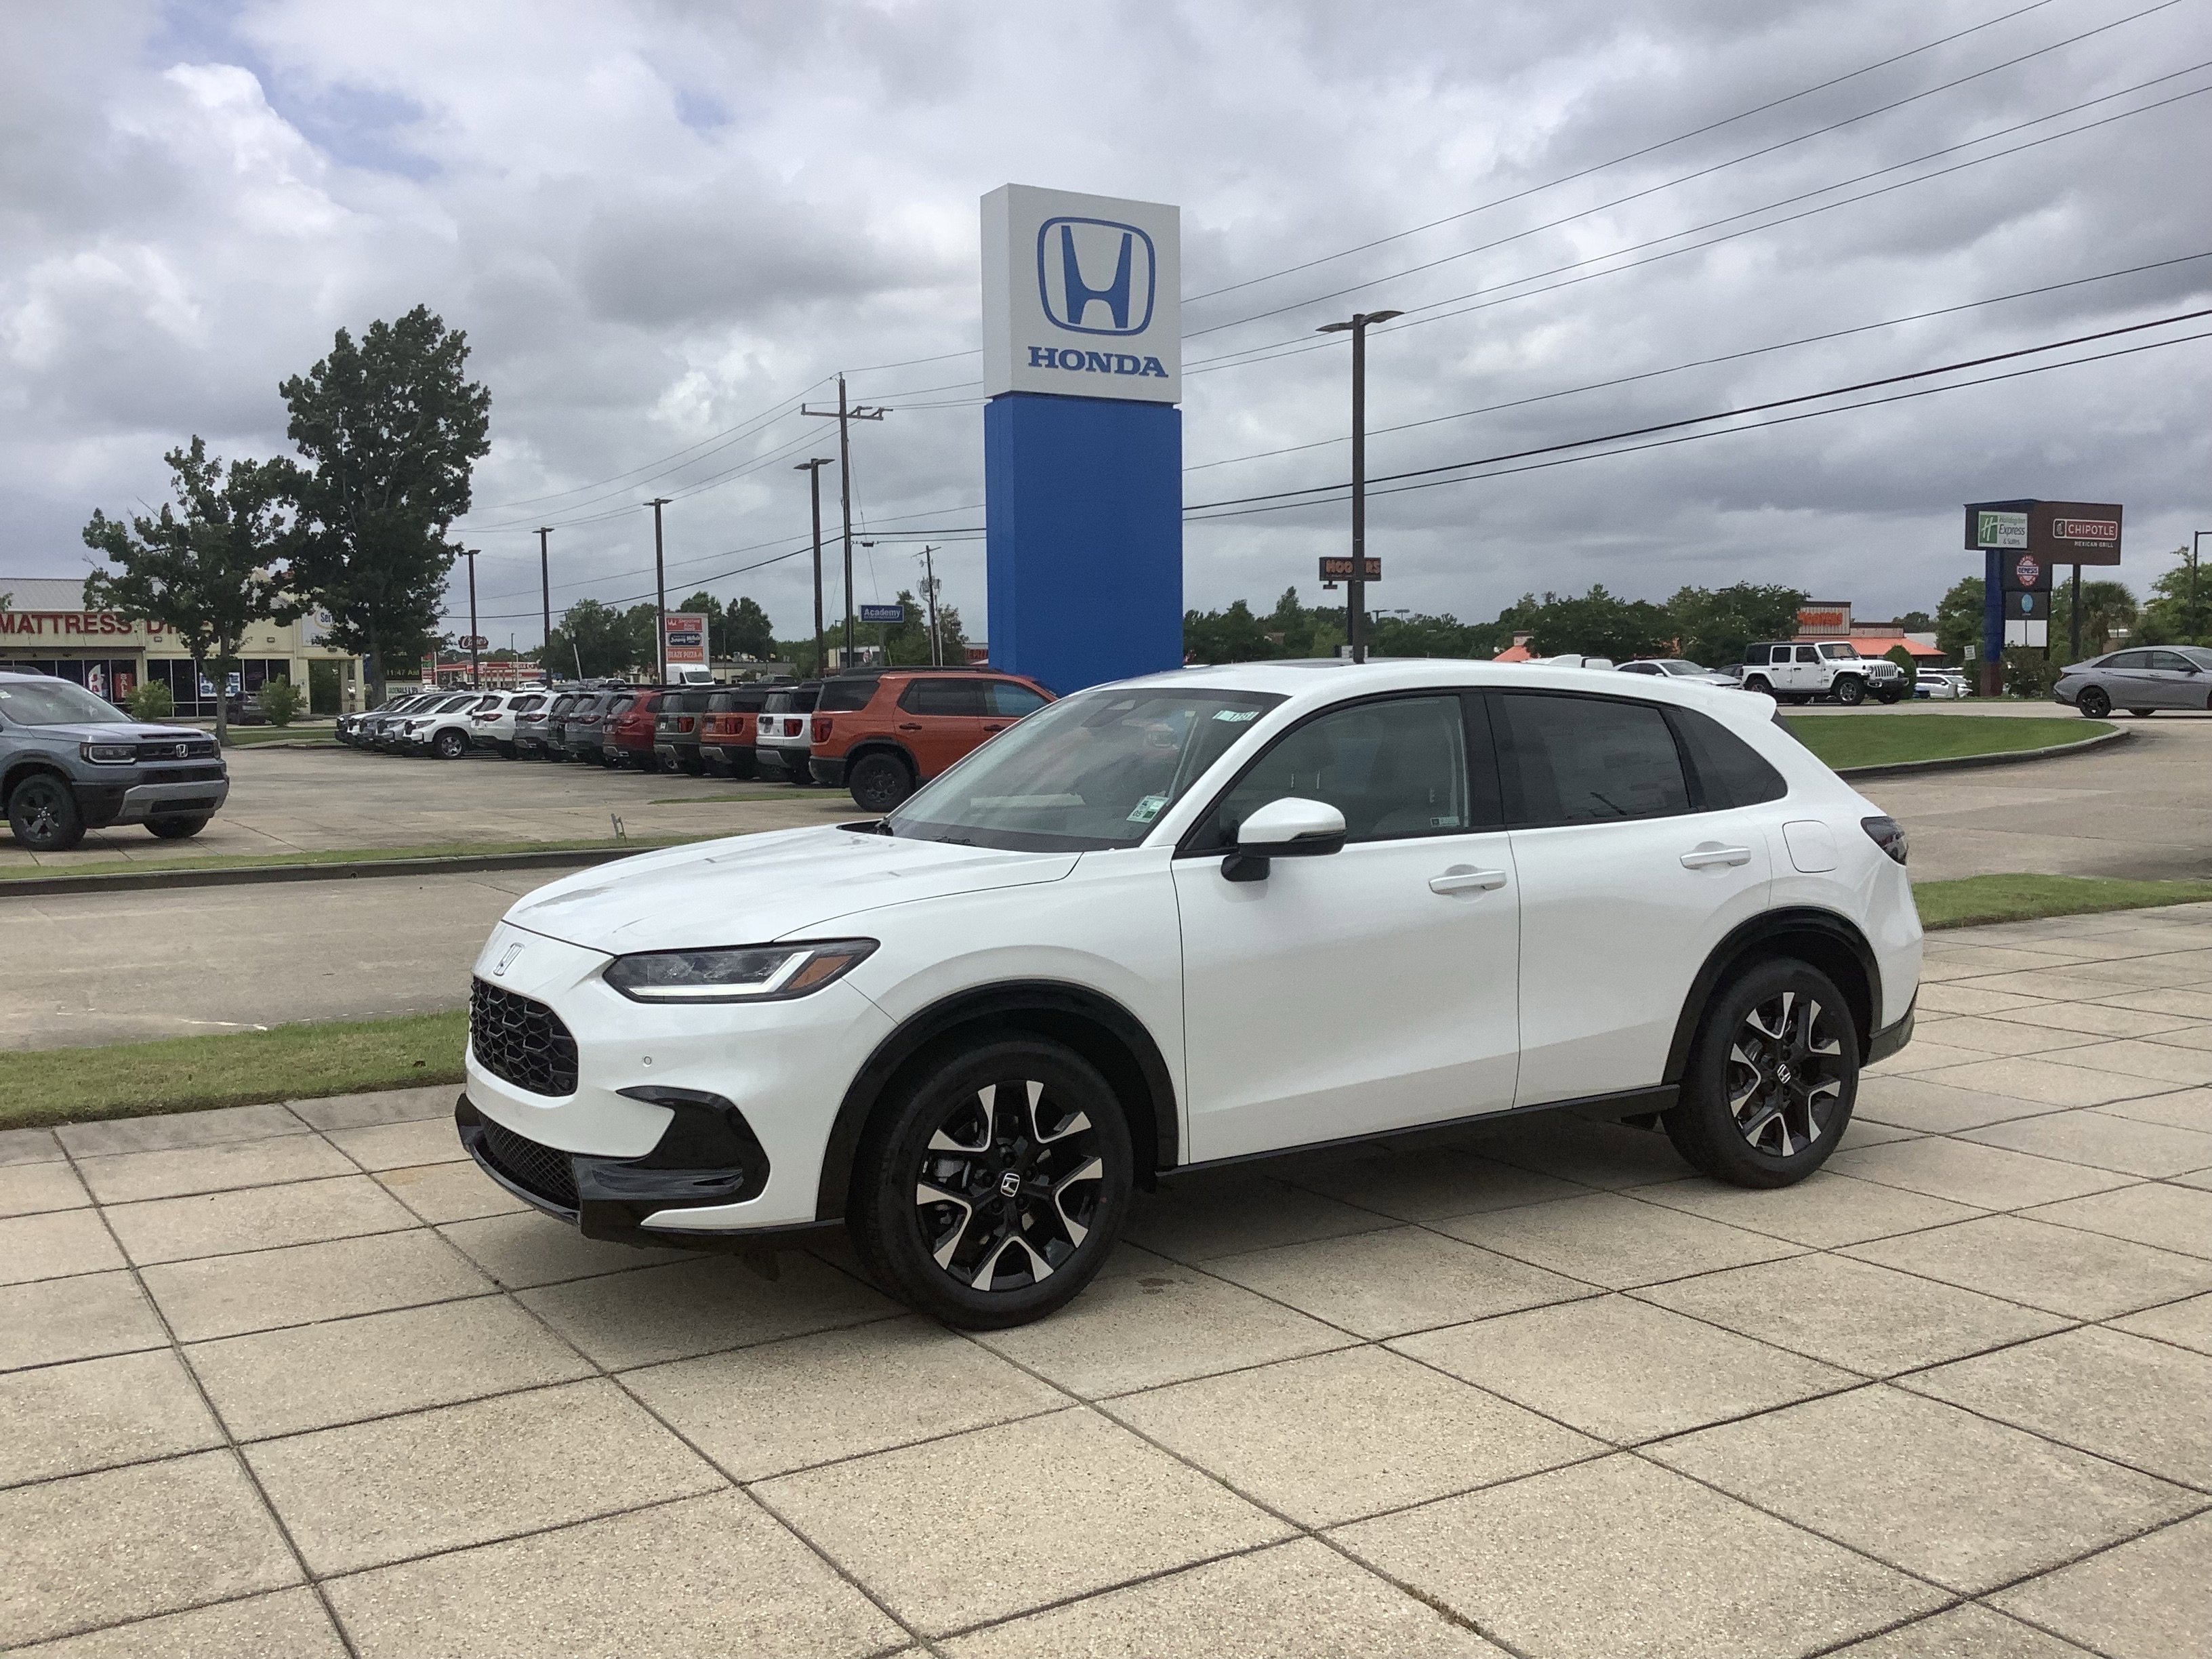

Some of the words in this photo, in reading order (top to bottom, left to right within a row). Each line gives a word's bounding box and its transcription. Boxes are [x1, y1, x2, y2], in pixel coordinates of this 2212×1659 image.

[1027, 345, 1169, 378] HONDA
[1999, 524, 2026, 537] Express
[2068, 524, 2114, 536] CHIPOTLE
[1326, 559, 1380, 573] HOORS
[863, 608, 901, 618] Academy
[0, 613, 132, 634] MATTRESS
